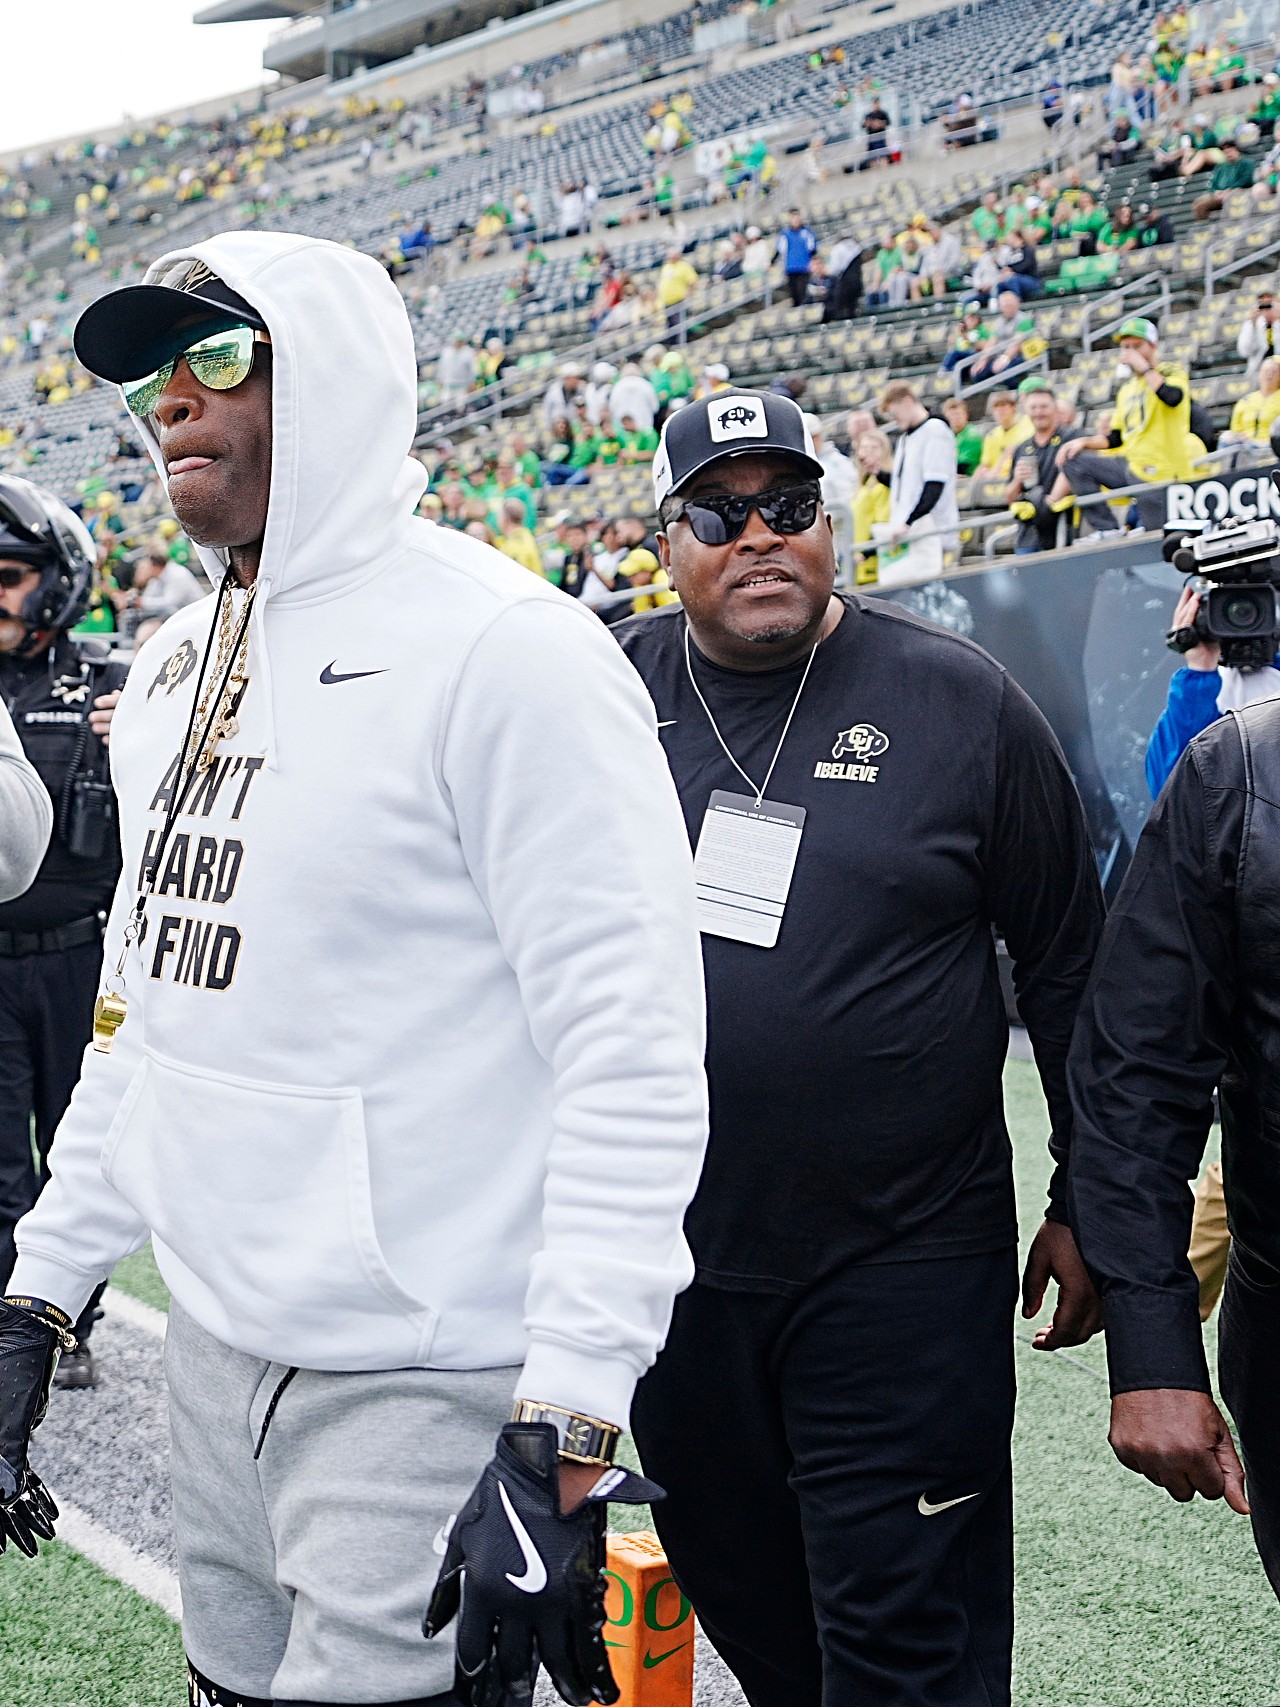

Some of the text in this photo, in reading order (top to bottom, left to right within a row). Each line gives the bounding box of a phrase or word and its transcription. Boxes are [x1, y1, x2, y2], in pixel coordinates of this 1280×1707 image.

[727, 408, 745, 419] CU
[766, 816, 797, 827] CREDENTIAL
[137, 828, 244, 907] HARD
[150, 913, 244, 993] FIND
